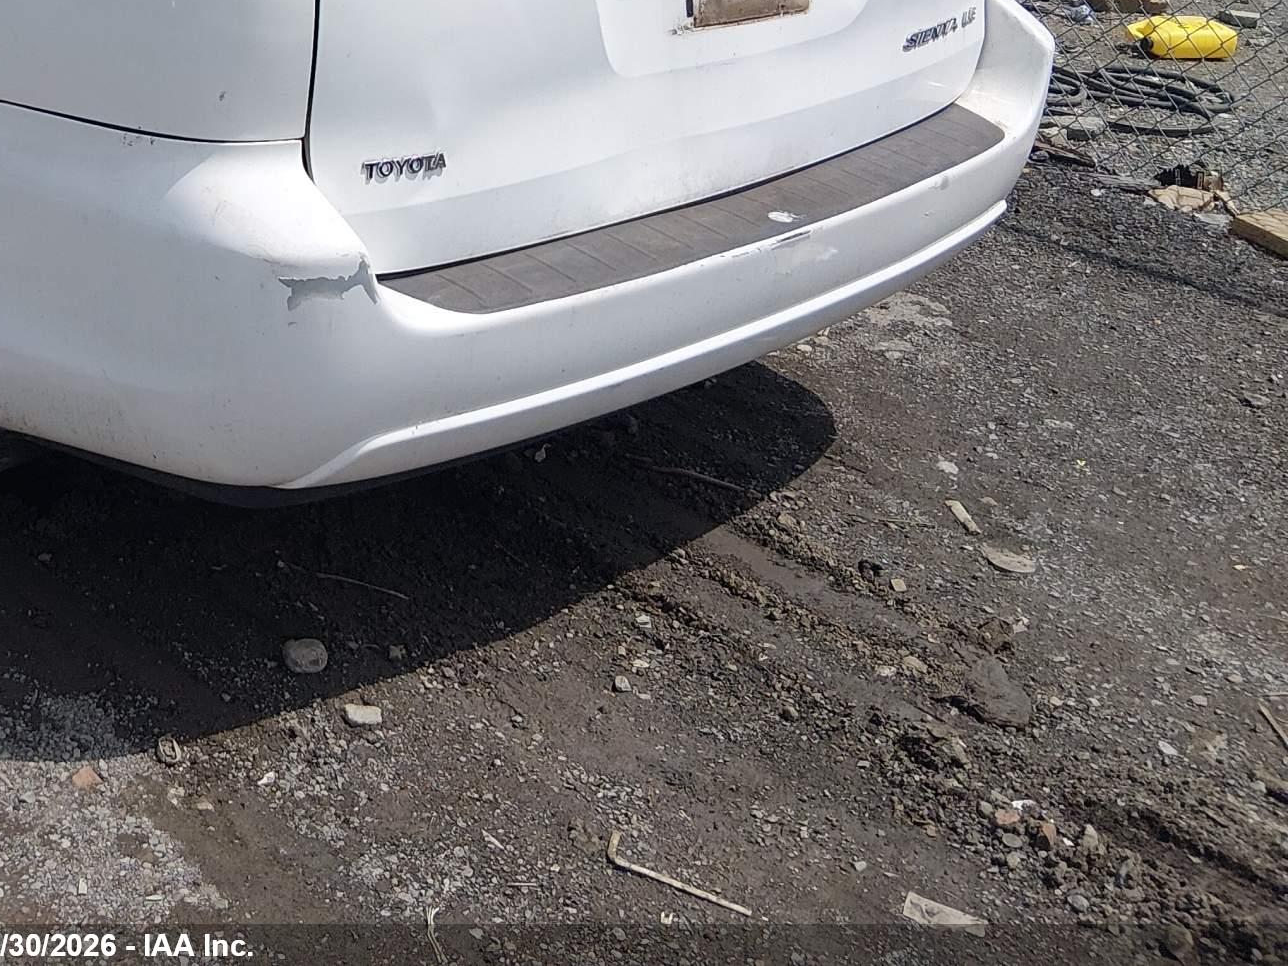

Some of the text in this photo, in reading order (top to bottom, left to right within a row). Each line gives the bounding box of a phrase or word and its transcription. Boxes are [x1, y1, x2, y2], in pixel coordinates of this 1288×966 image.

[903, 7, 977, 51] SIENNA LE
[362, 152, 447, 183] TOYOTA
